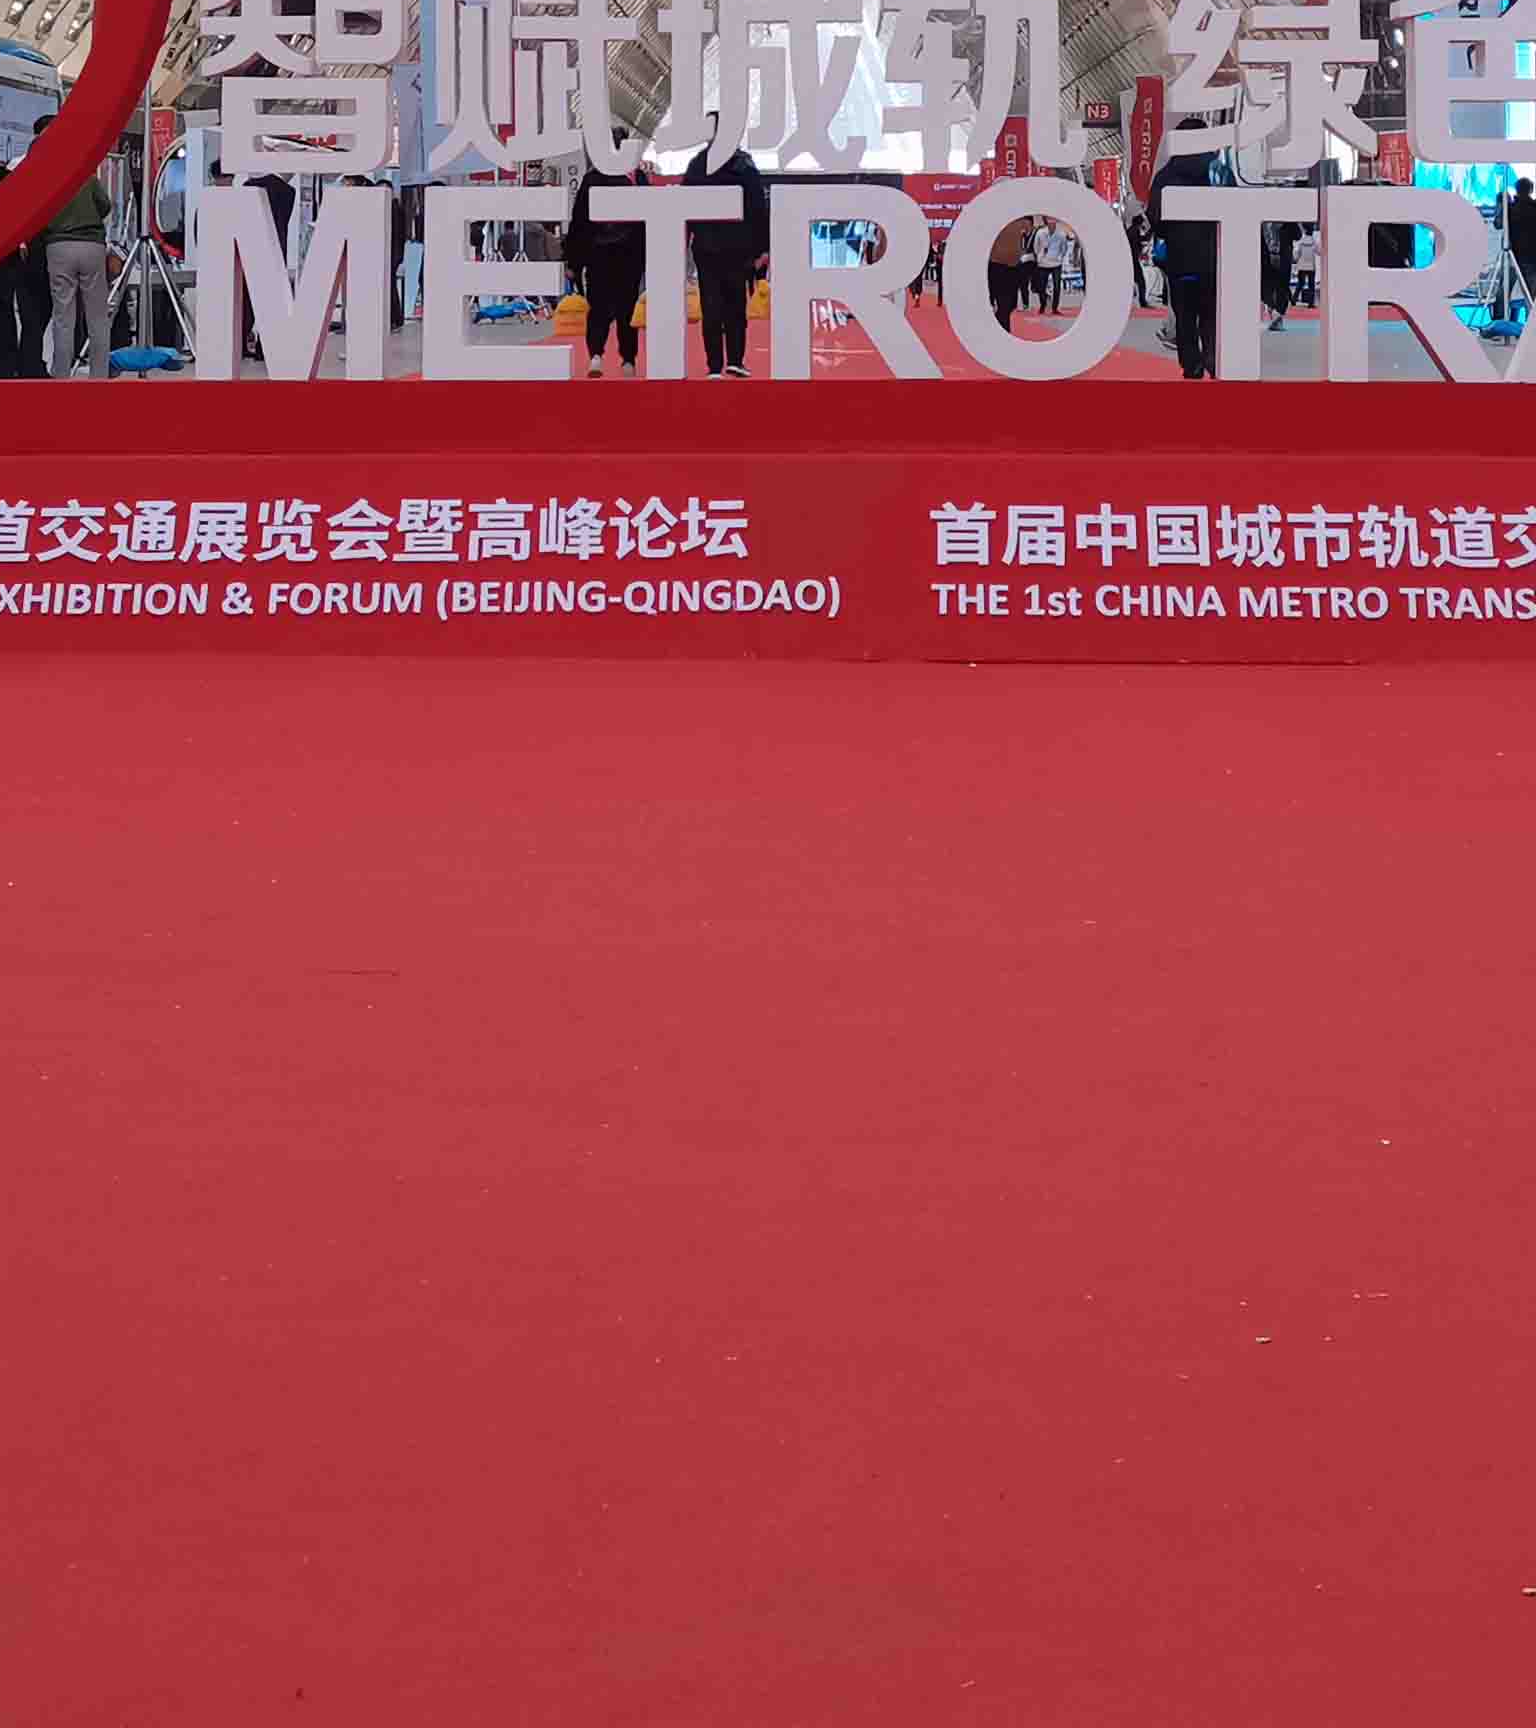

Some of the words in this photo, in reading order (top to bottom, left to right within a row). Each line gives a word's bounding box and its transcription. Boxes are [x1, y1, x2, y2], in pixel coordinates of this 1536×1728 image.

[1087, 104, 1110, 119] N3
[1139, 118, 1152, 175] CRRC
[222, 582, 254, 614] &
[269, 582, 422, 614] FORUM
[437, 577, 840, 620] (BEIJING-QINGDAO)
[931, 584, 1010, 615] THE
[1025, 584, 1083, 617] 1st
[1096, 585, 1227, 617] CHINA
[1239, 587, 1389, 619] METRO
